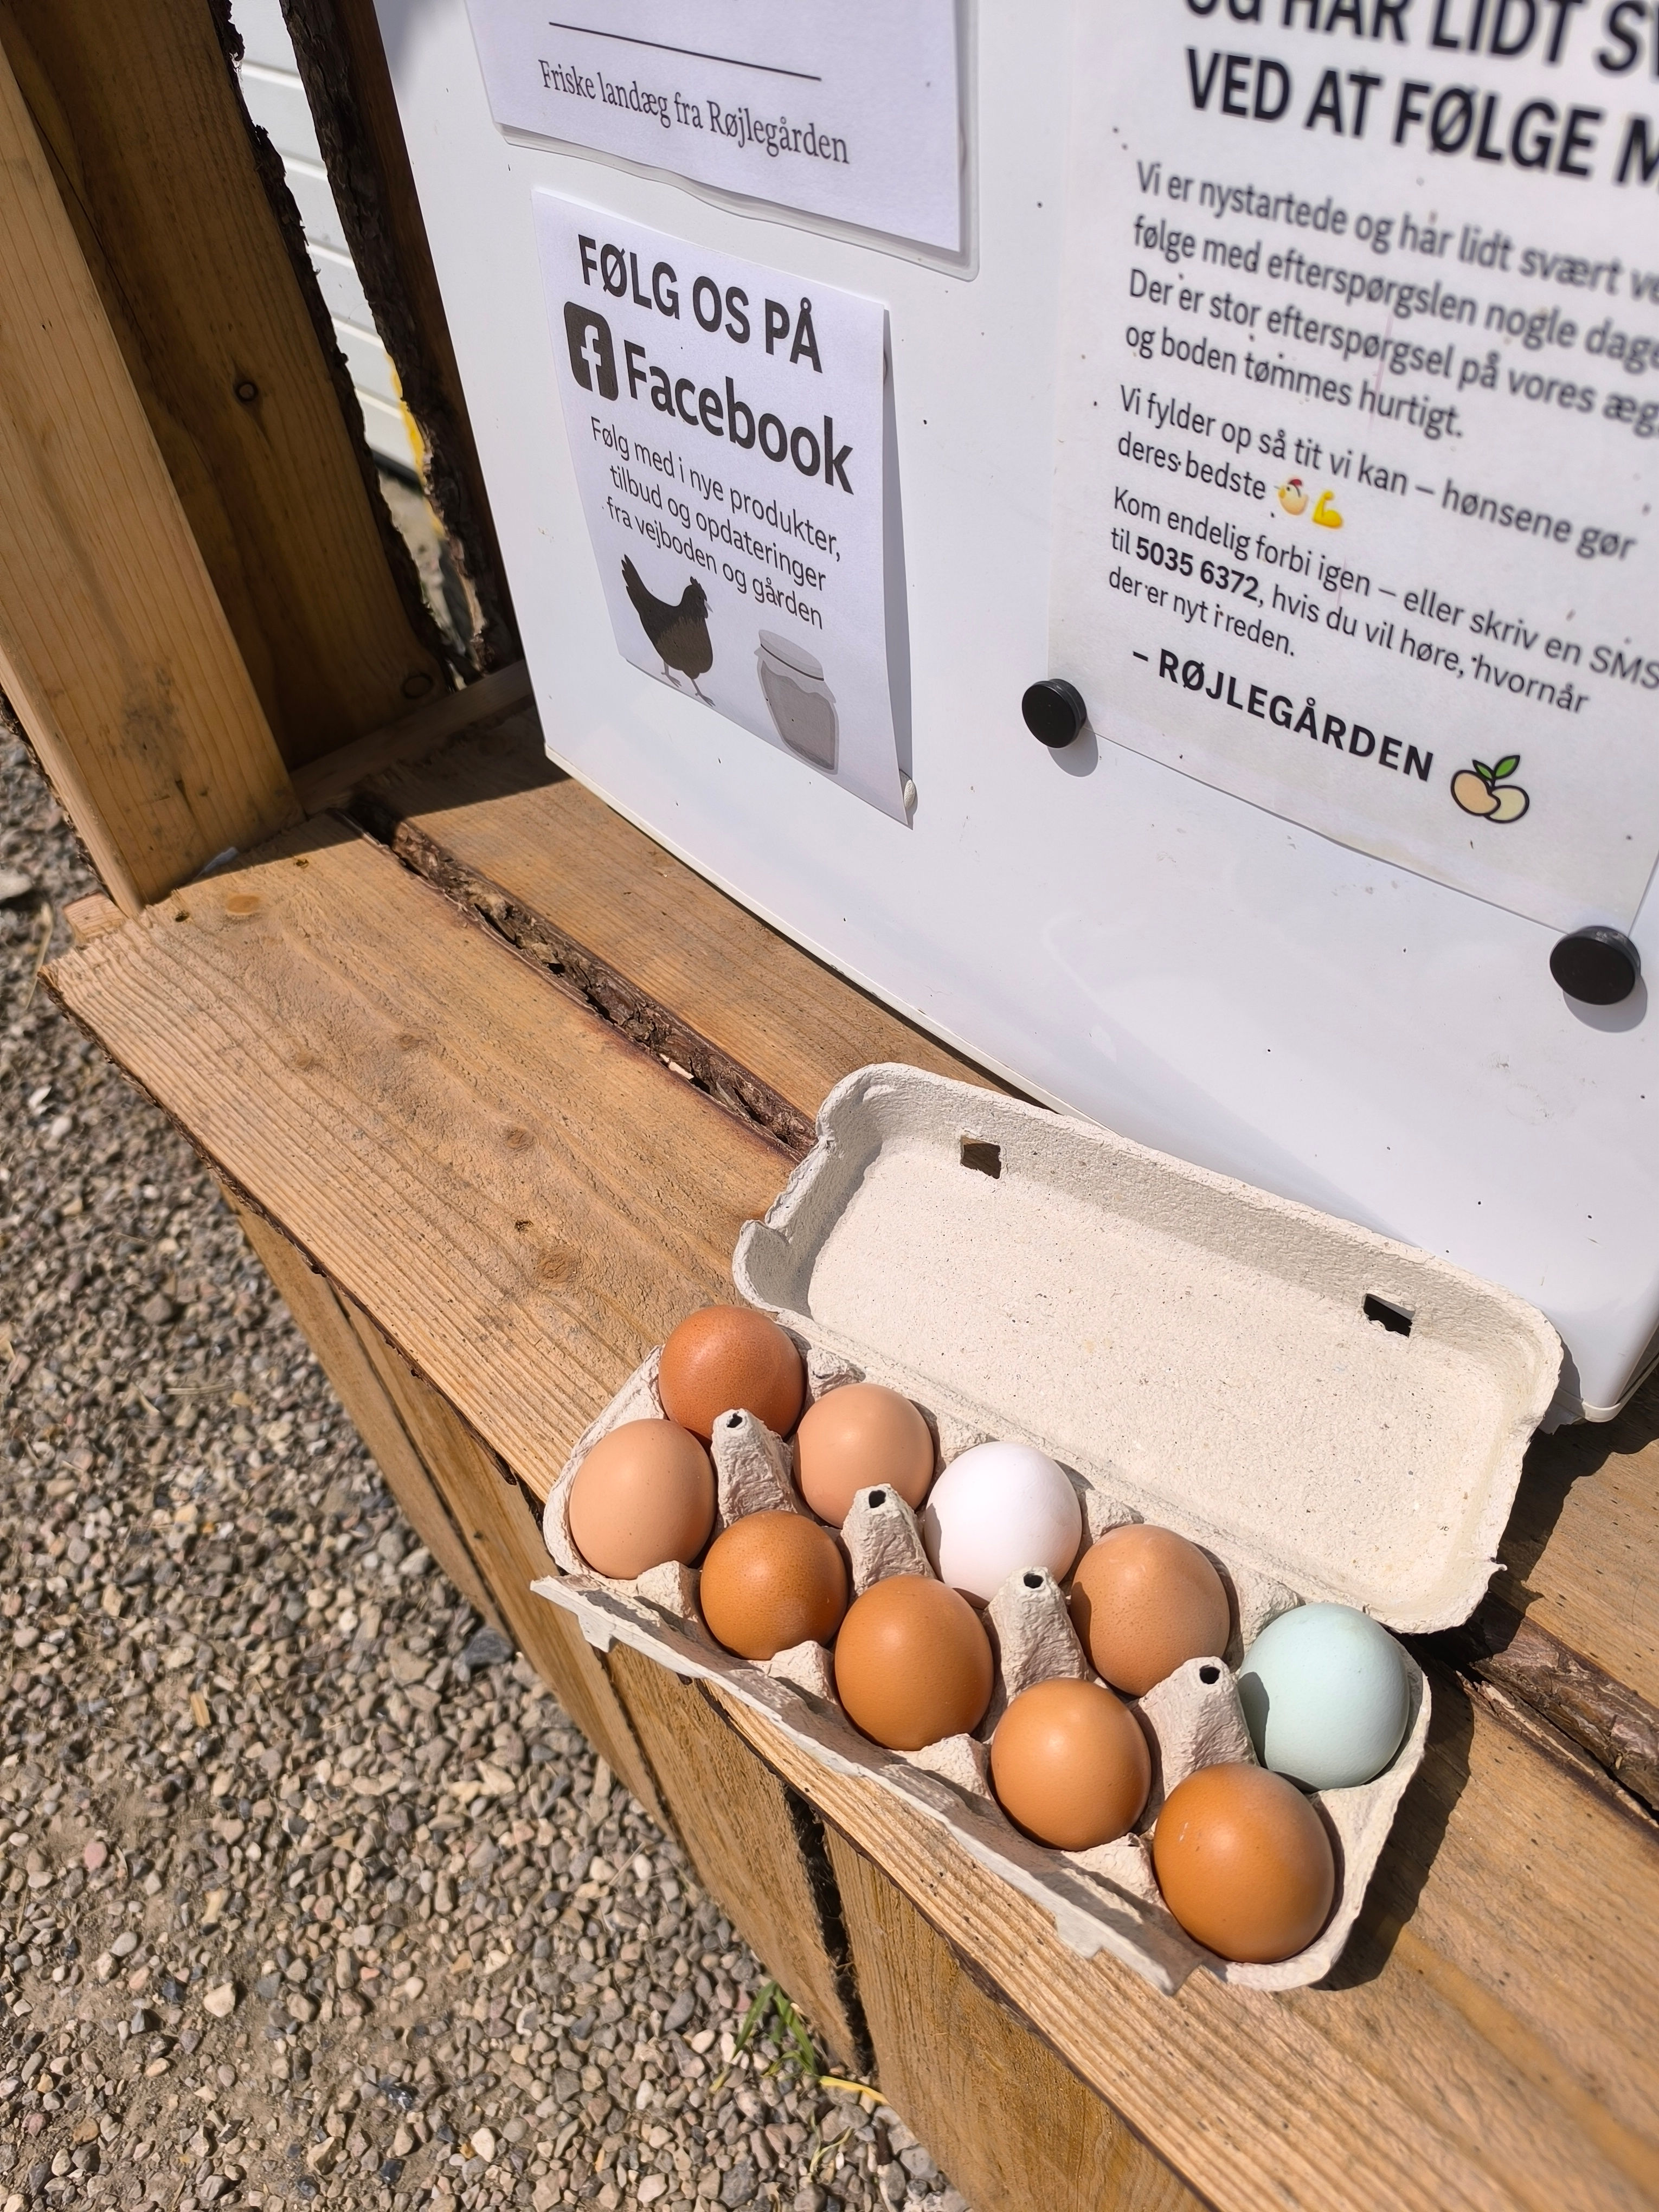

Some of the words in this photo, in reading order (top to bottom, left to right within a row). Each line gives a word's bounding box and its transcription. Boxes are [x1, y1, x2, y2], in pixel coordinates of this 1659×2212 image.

[1432, 0, 1584, 62] LIDT
[1598, 0, 1659, 76] S
[539, 60, 596, 100] Friske
[597, 73, 669, 128] landæg
[674, 92, 704, 129] fra
[706, 100, 850, 164] Røjlegården
[1187, 49, 1290, 120] VED
[1306, 70, 1381, 136] AT
[1394, 82, 1600, 176] FØLGE
[1134, 214, 1195, 263] følge
[1201, 239, 1262, 274] med
[1268, 248, 1478, 325] efterspørgslen
[1484, 304, 1578, 351] nogle
[1136, 160, 1161, 196] Vi
[1168, 175, 1195, 202] er
[1199, 181, 1347, 235] nystartede
[1355, 214, 1395, 255] og
[1398, 213, 1454, 258] har
[1458, 224, 1515, 272] lidt
[1519, 246, 1624, 296] svært
[578, 234, 680, 320] FØLG
[692, 276, 750, 344] OS
[765, 297, 822, 374] PÅ
[1130, 268, 1174, 305] Der
[1179, 287, 1204, 313] er
[1209, 291, 1262, 327] stor
[1267, 304, 1455, 378] efterspørgsel
[1458, 350, 1501, 391] på
[1508, 369, 1596, 413] vores
[1603, 393, 1659, 439] æg
[624, 339, 854, 496] Facebook
[1126, 326, 1155, 359] og
[1161, 327, 1237, 375] boden
[1245, 352, 1353, 406] tømmes
[1359, 380, 1463, 440] hurtigt.
[591, 416, 629, 461] Følg
[634, 442, 674, 478] med
[679, 457, 684, 483] i
[690, 468, 724, 501] nye
[730, 487, 841, 562] produkter,
[610, 465, 663, 510] tilbud
[668, 498, 691, 529] og
[696, 512, 826, 591] opdateringer
[1118, 431, 1179, 472] deres
[1185, 451, 1266, 500] bedste
[1121, 384, 1141, 414] Vi
[1147, 393, 1216, 436] fylder
[1221, 422, 1251, 455] op
[1258, 429, 1287, 460] så
[1294, 439, 1322, 471] tit
[1330, 450, 1353, 478] vi
[1358, 454, 1407, 496] kan
[1442, 478, 1573, 543] hønsene
[1576, 526, 1637, 561] gør
[606, 496, 633, 530] fra
[635, 516, 717, 575] vejboden
[723, 563, 747, 595] og
[753, 577, 822, 630] gården
[1109, 567, 1142, 597] der
[1147, 586, 1169, 607] er
[1174, 595, 1208, 623] nyt
[1214, 603, 1220, 628] i
[1225, 619, 1295, 657] reden.
[1111, 528, 1130, 555] til
[1136, 536, 1193, 576] 5035
[1200, 561, 1264, 608] 6372,
[1272, 584, 1320, 623] hvis
[1326, 607, 1357, 637] du
[1366, 621, 1394, 650] vil
[1400, 628, 1464, 679] høre,
[1474, 654, 1590, 713] hvornår
[1114, 486, 1160, 525] Kom
[1168, 511, 1251, 561] endelig
[1256, 535, 1313, 576] forbi
[1318, 554, 1371, 596] igen
[1404, 588, 1465, 626] eller
[1469, 610, 1540, 650] skriv
[1545, 637, 1582, 666] en
[1589, 646, 1659, 689] SMS
[1159, 648, 1434, 782] RØJLEGÅRDEN
